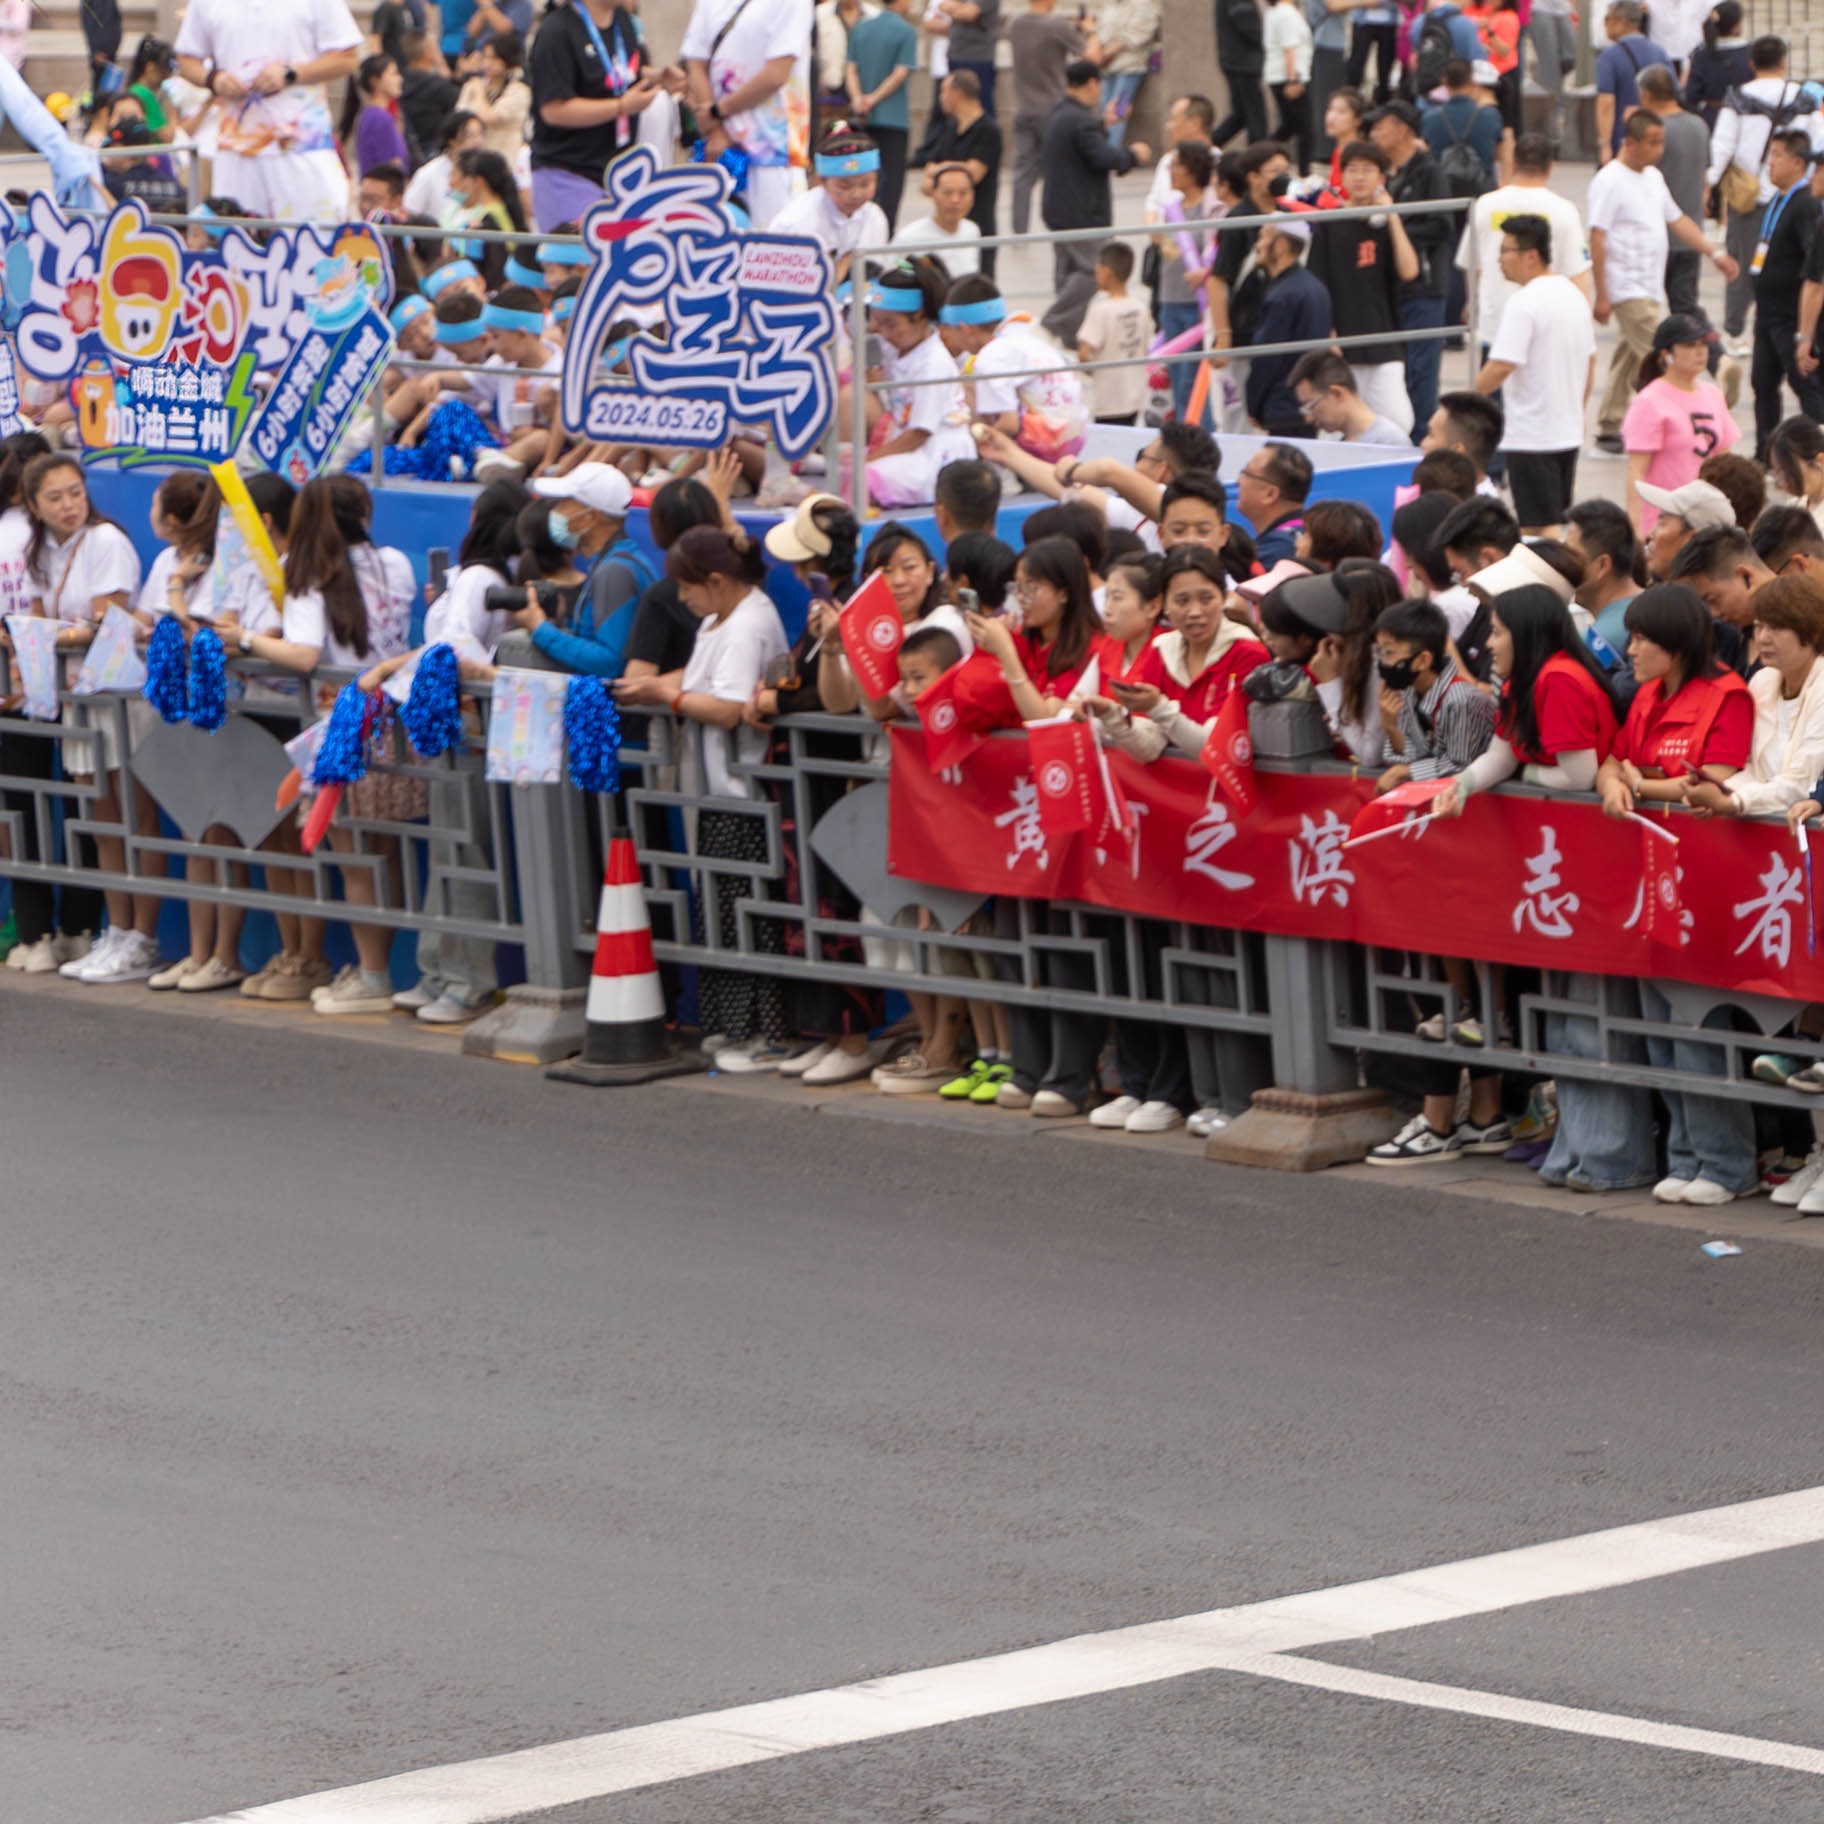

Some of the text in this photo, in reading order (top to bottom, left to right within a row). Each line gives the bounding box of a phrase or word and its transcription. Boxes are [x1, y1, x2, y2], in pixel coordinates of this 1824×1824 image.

[104, 402, 230, 455] 加油兰州
[595, 401, 718, 431] 2024.05.26
[1690, 412, 1720, 457] 5
